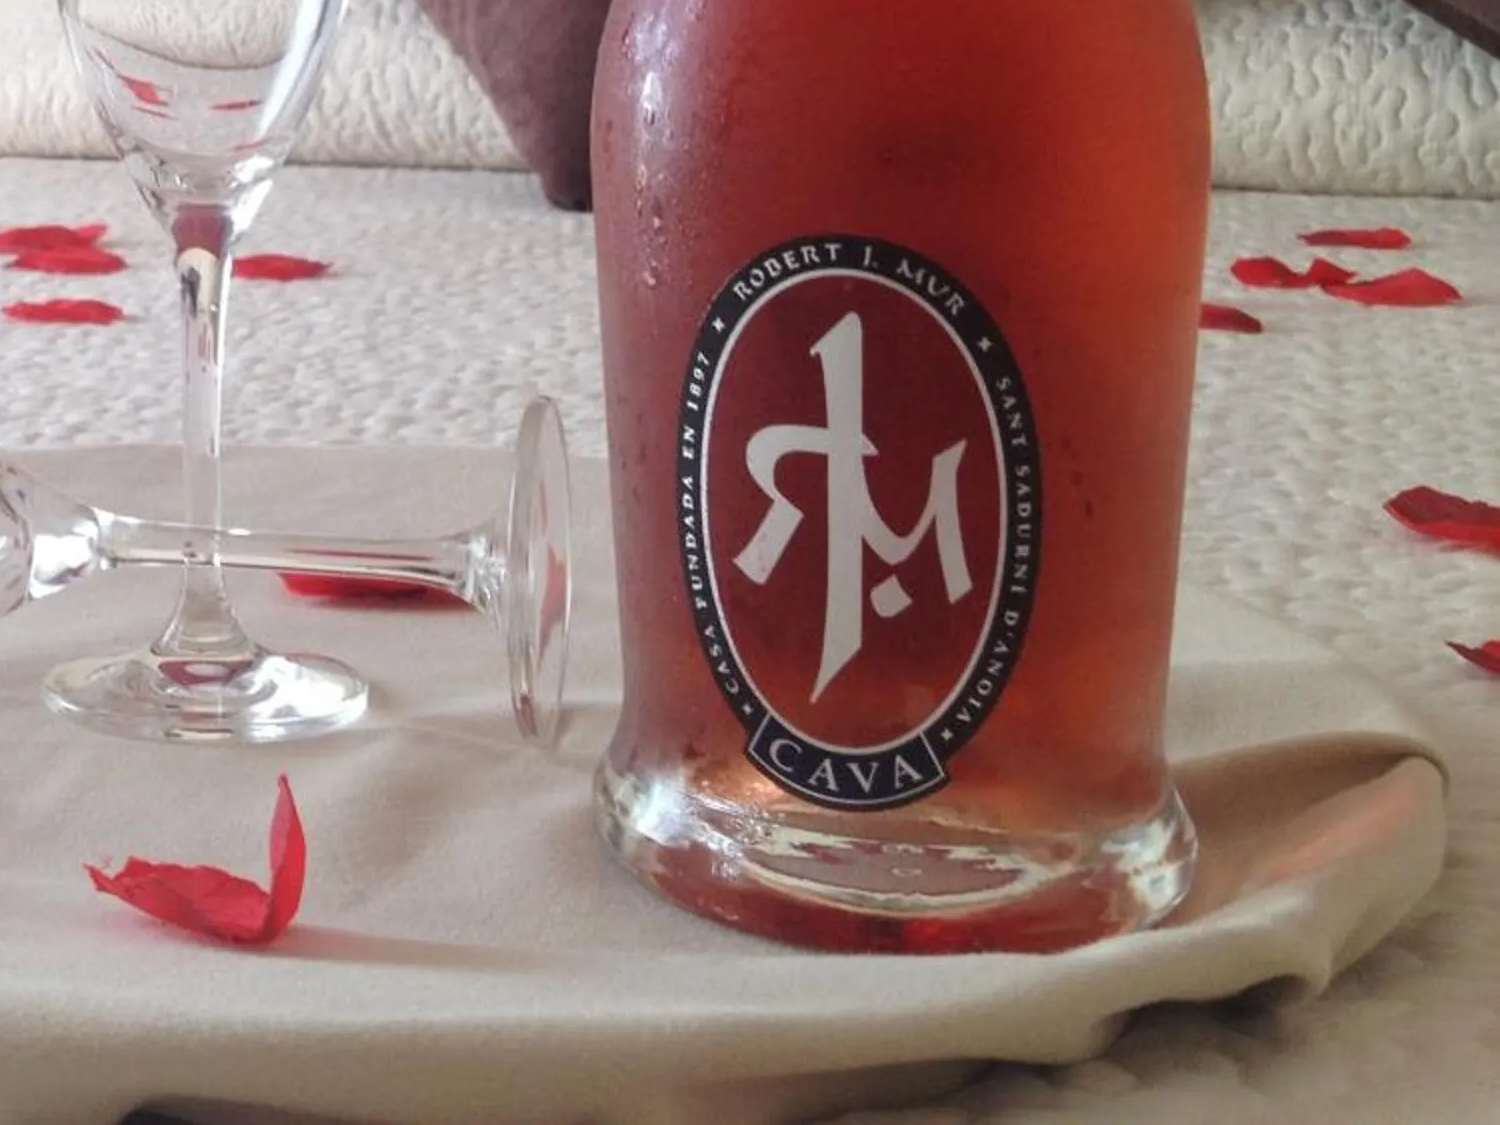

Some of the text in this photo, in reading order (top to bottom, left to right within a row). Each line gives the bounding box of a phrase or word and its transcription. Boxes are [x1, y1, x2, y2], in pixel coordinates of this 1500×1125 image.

[732, 243, 842, 301] ROBERT
[996, 377, 1028, 447] SANT
[681, 351, 739, 695] CASA FUNDADA EN 1897
[769, 738, 924, 793] CAVA
